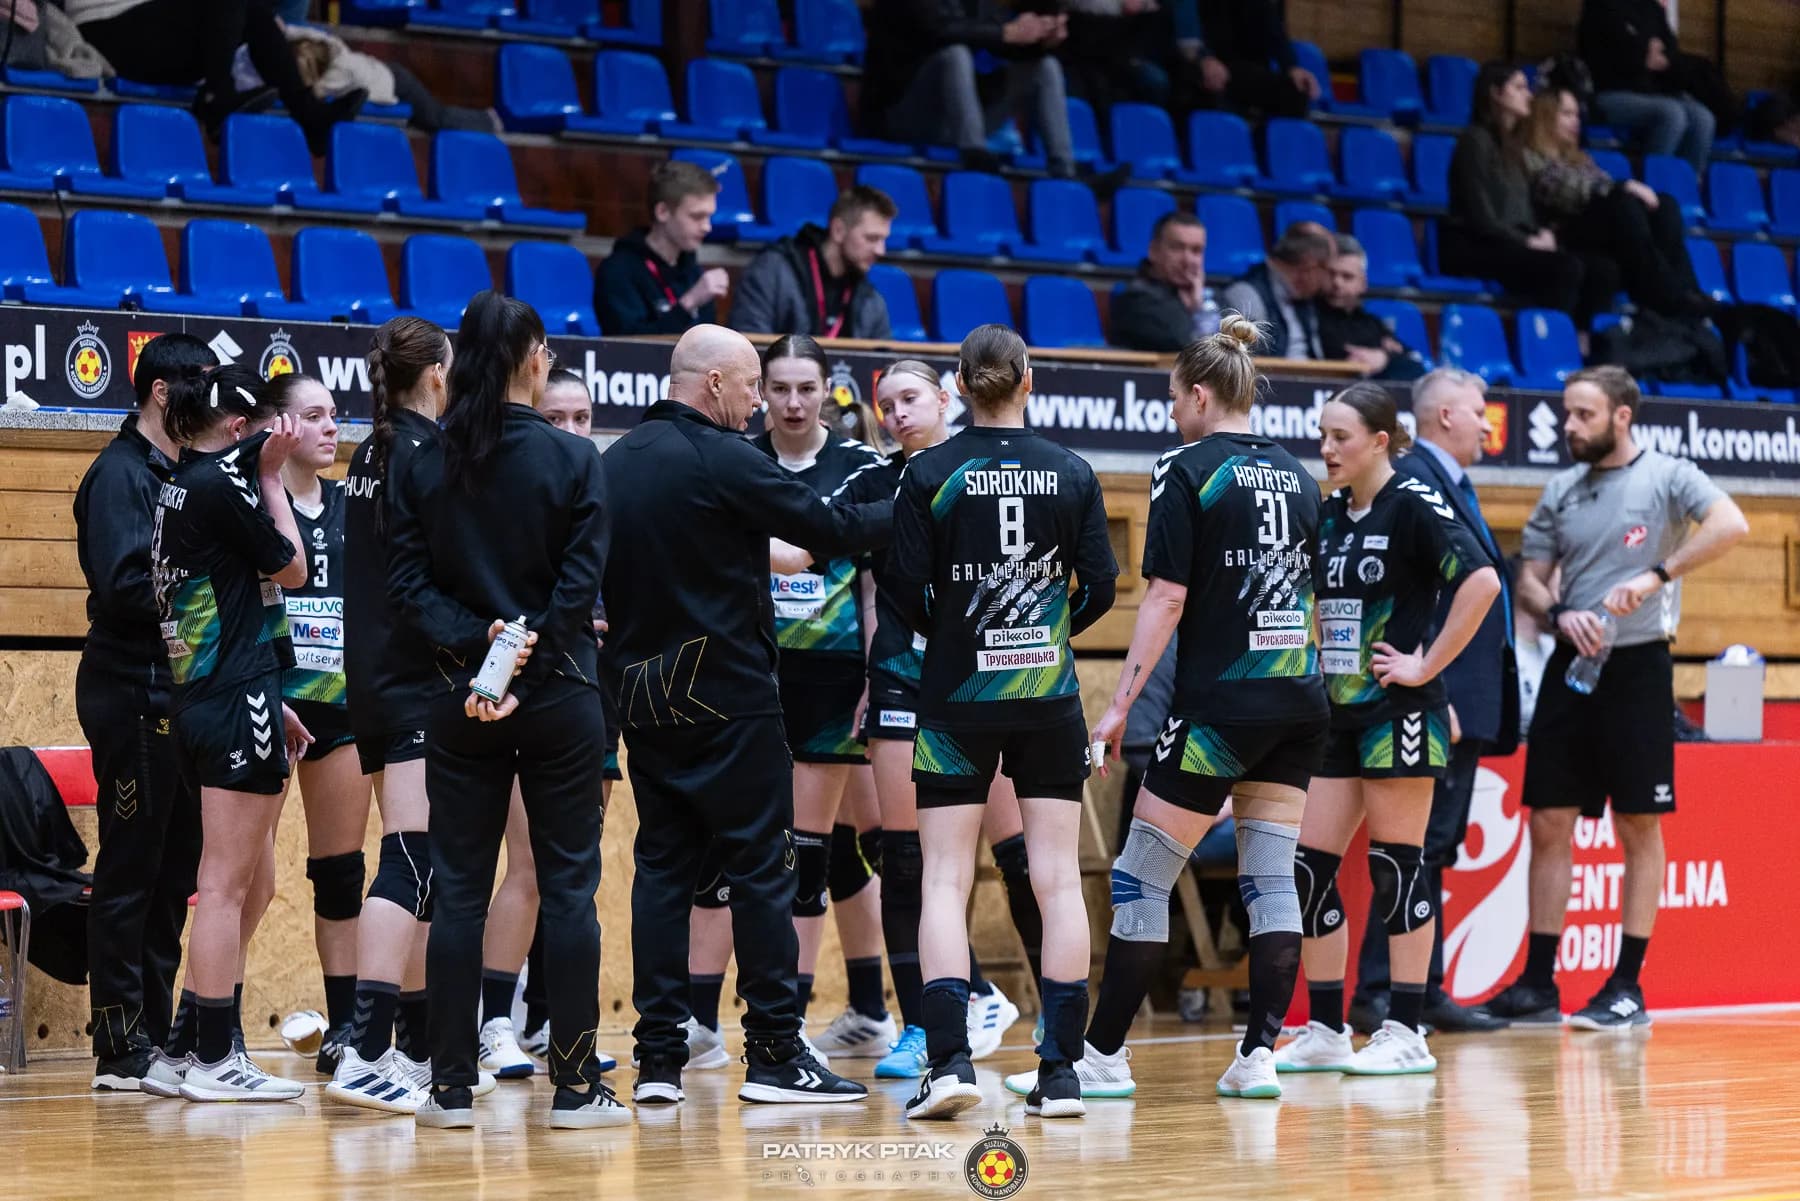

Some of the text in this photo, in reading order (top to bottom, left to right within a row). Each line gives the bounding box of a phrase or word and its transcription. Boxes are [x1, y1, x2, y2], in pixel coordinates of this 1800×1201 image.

[964, 470, 1058, 495] SOROKINA
[1232, 465, 1302, 494] HAVRYSH
[998, 496, 1025, 555] 8
[1255, 489, 1290, 546] 31
[313, 554, 329, 588] 3
[770, 577, 815, 594] Meest
[1327, 555, 1347, 588] 21
[983, 650, 1055, 667] Трускавецька
